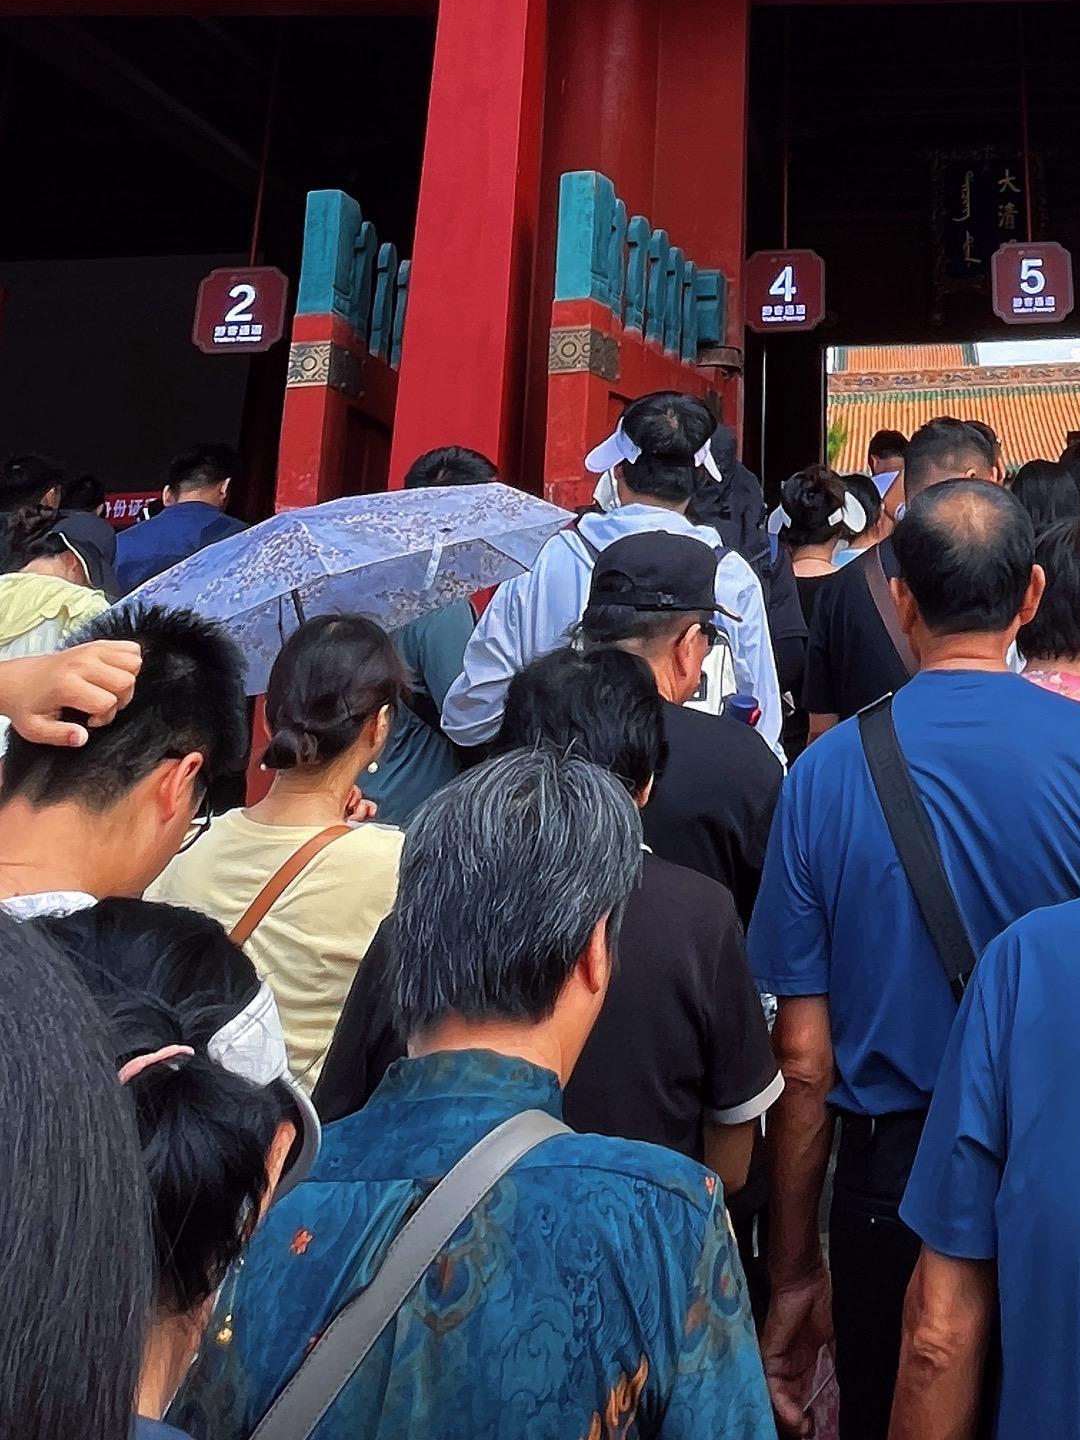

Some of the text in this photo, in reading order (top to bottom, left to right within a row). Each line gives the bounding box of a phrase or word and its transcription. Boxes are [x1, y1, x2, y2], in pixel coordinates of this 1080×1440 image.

[769, 265, 797, 302] 4
[1020, 258, 1046, 294] 5
[225, 284, 256, 322] 2
